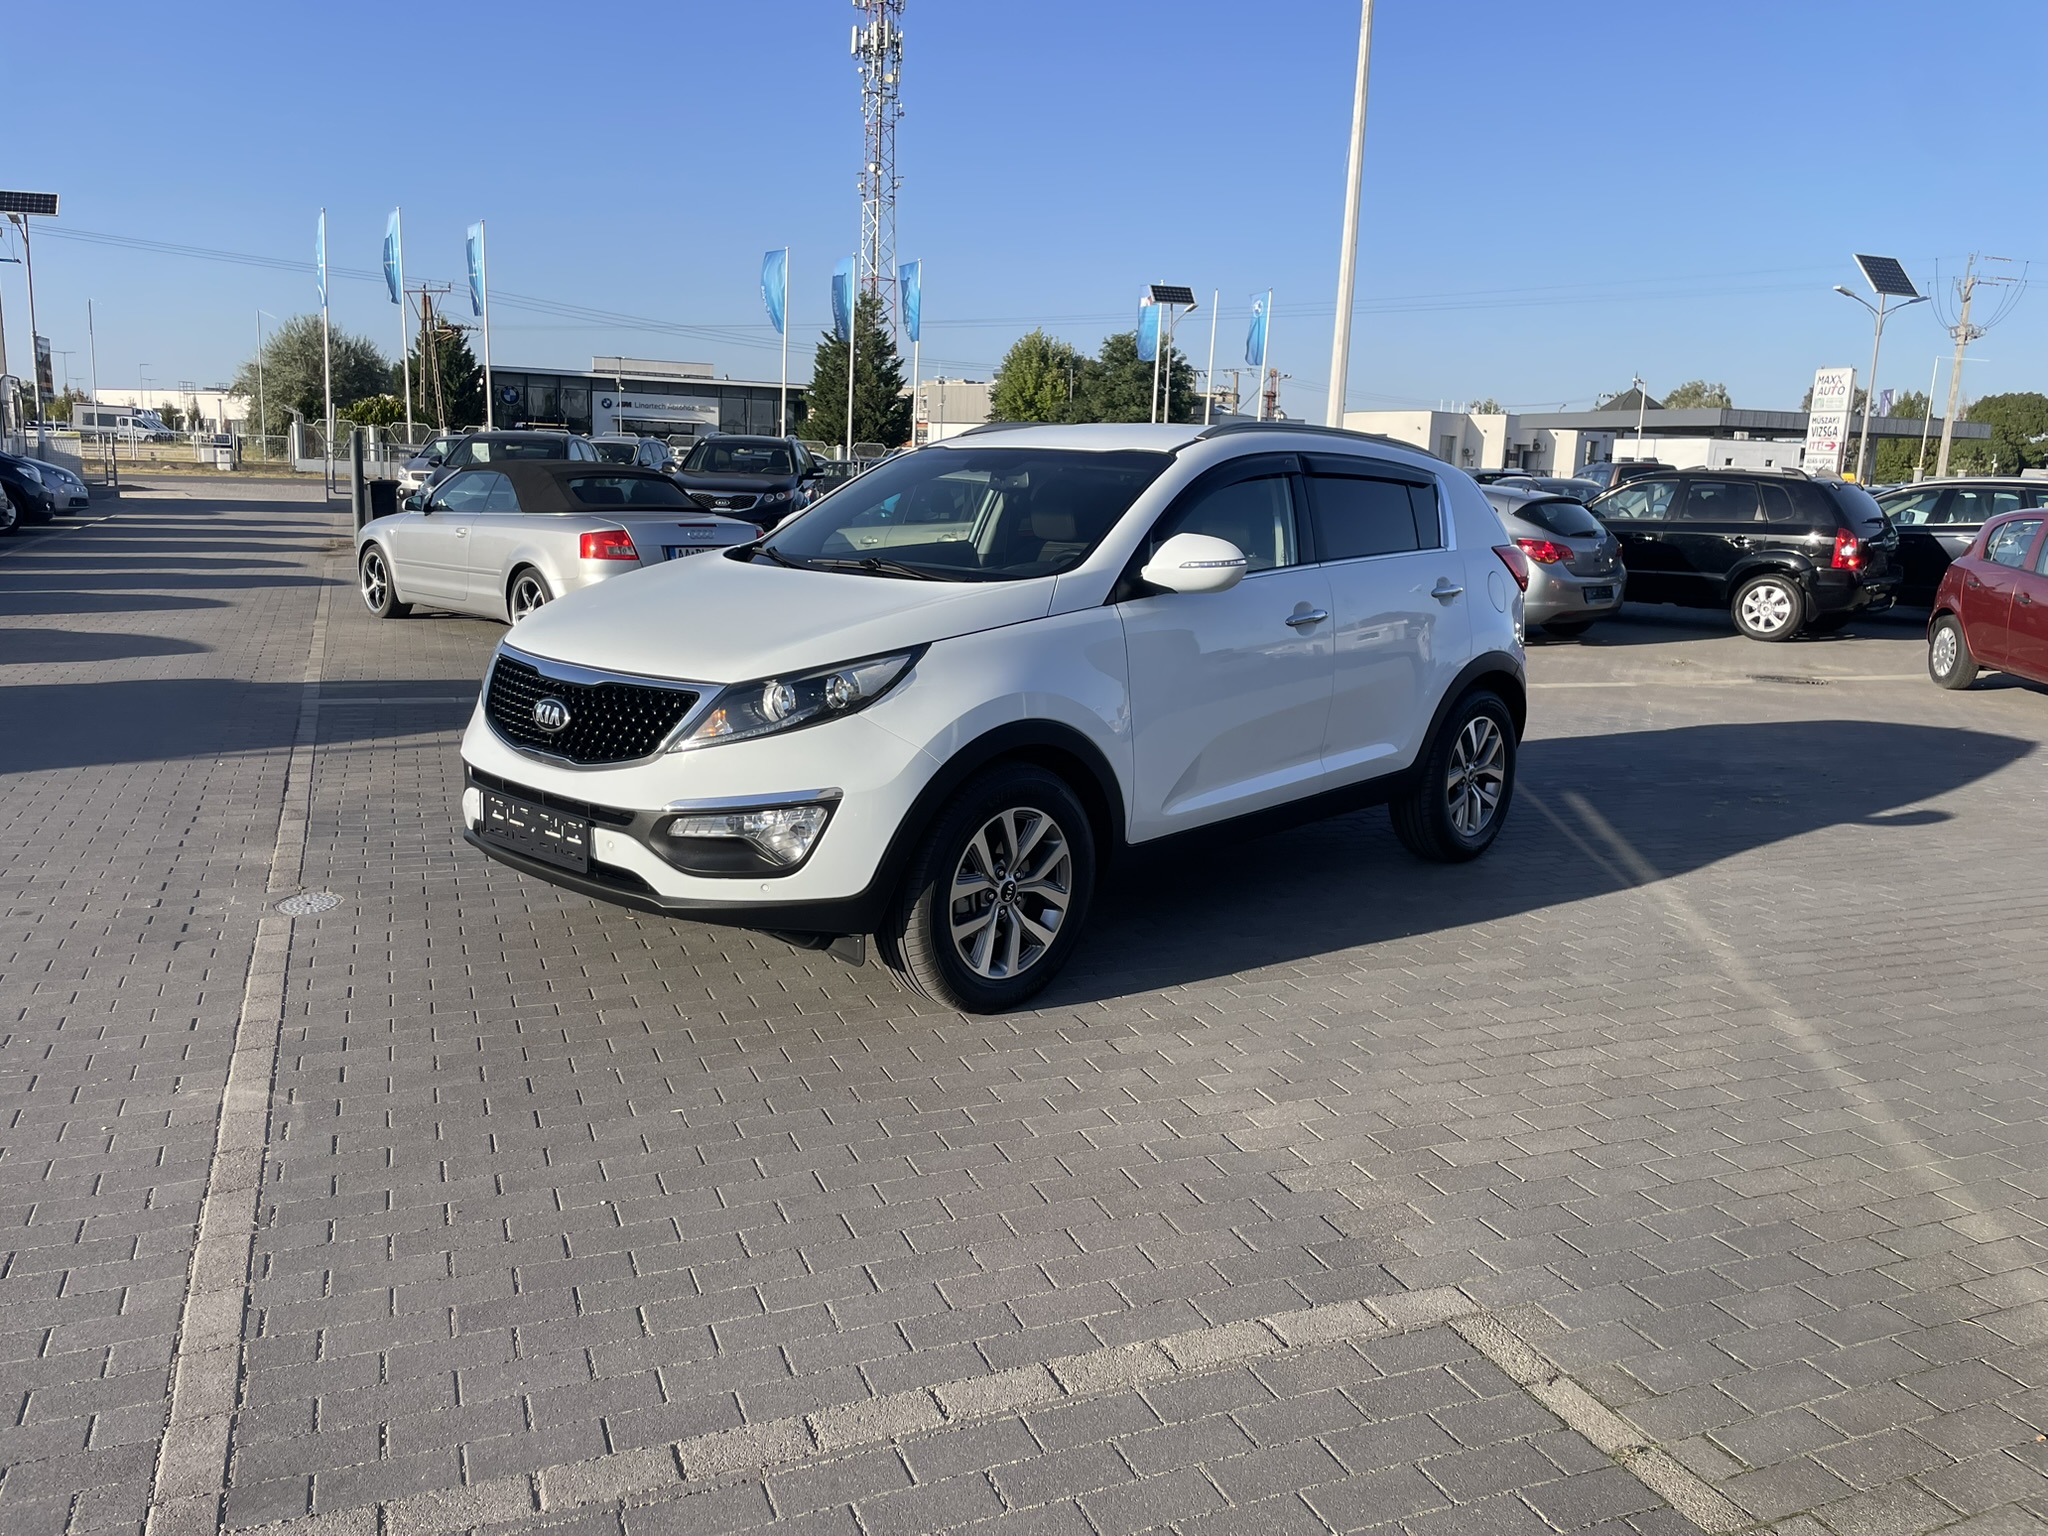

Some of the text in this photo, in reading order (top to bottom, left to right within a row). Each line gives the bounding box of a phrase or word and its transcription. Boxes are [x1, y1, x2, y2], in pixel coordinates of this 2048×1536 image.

[1817, 374, 1843, 385] MAXX
[634, 402, 667, 410] Linartech
[1811, 426, 1838, 437] VIZSGA
[535, 703, 560, 726] KIA
[1005, 883, 1014, 901] KIA
